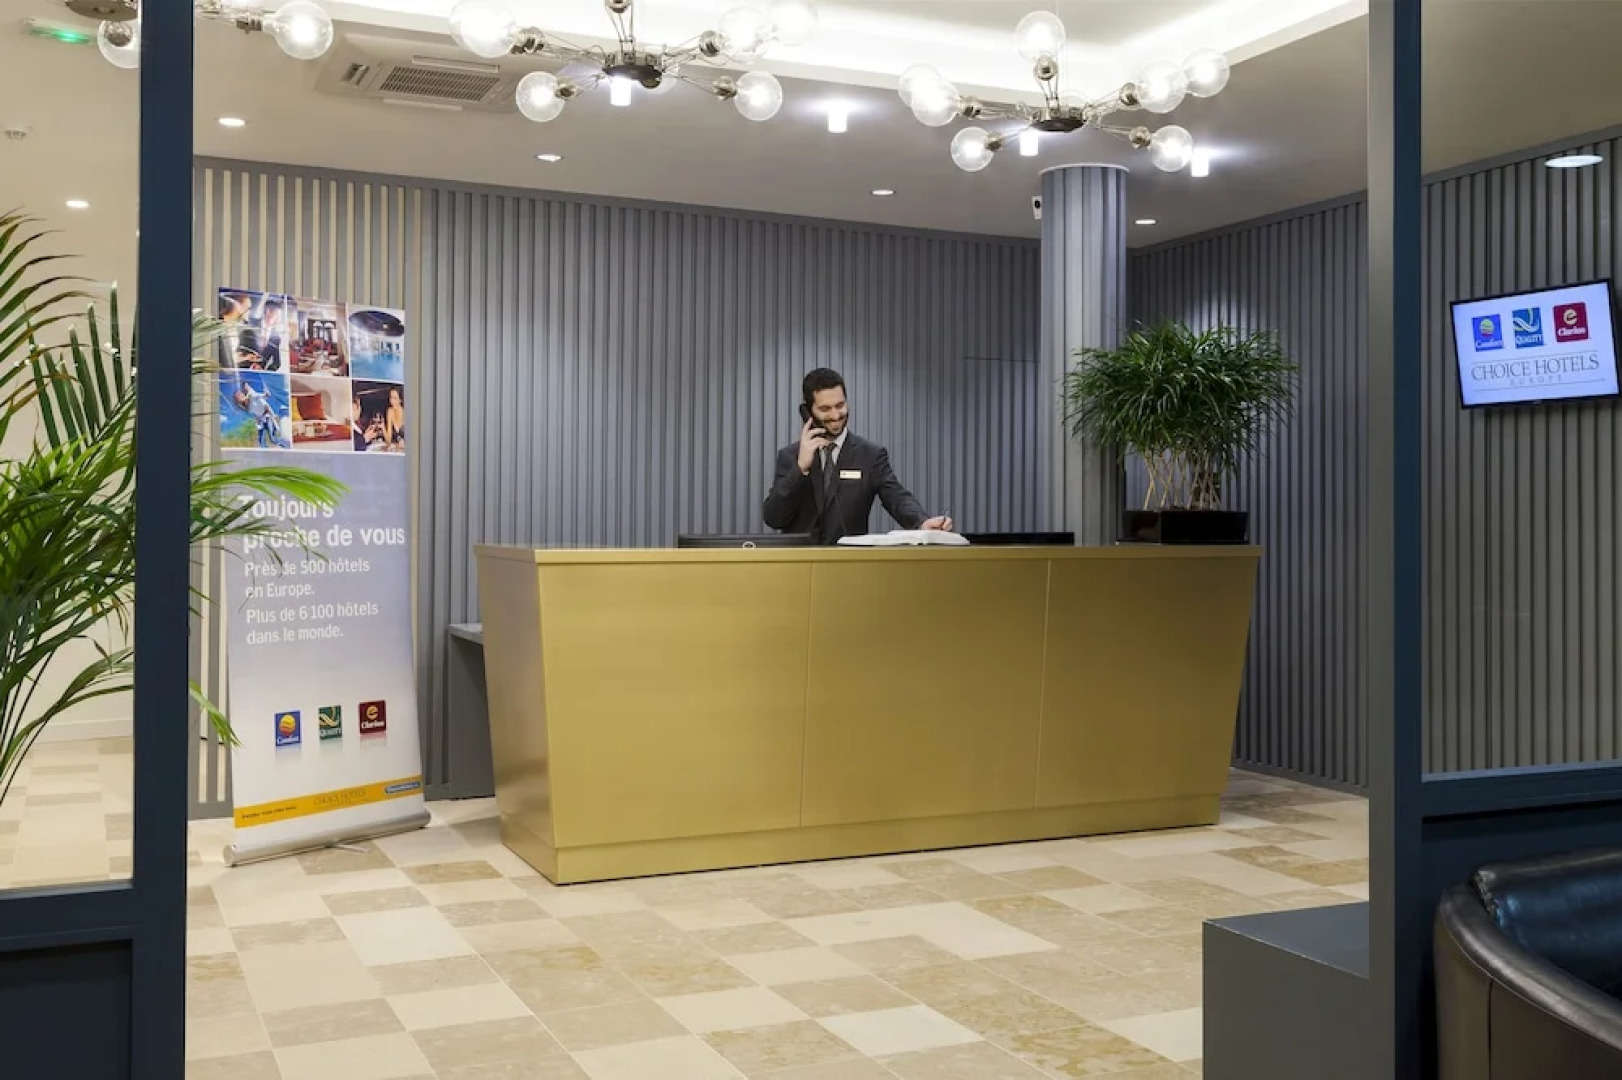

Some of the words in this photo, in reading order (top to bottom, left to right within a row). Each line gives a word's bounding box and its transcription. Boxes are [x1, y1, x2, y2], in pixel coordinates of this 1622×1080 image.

[1471, 361, 1531, 381] CHOICE
[1535, 354, 1600, 375] HOTELS
[1510, 375, 1563, 385] EUROPE
[326, 524, 353, 546] de
[360, 527, 405, 546] vous
[244, 561, 277, 577] Près
[282, 559, 296, 575] de
[301, 560, 325, 575] 500
[328, 558, 371, 573] hôtels
[245, 586, 264, 598] en
[267, 582, 316, 598] Europe.
[246, 608, 277, 624] Plus
[280, 607, 296, 621] de
[337, 602, 379, 617] hôtels
[246, 630, 280, 645] dans
[283, 628, 295, 642] le
[298, 624, 344, 640] monde.
